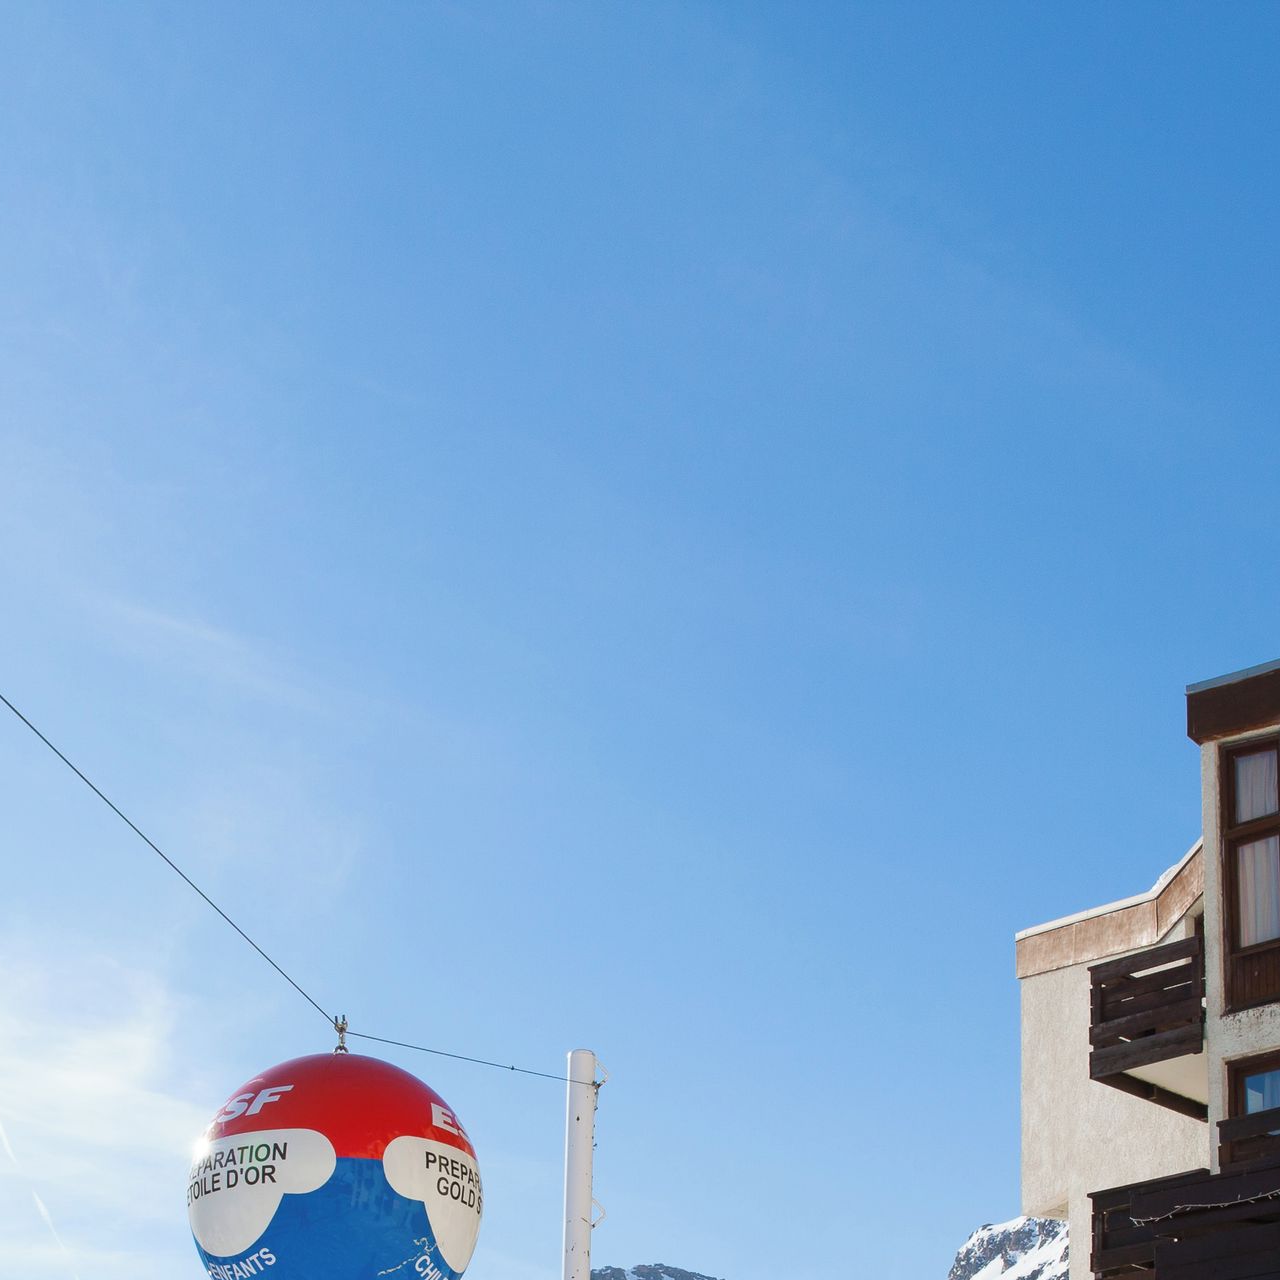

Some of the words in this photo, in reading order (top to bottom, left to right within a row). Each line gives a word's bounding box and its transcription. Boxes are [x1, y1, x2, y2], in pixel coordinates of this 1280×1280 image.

[217, 1084, 294, 1123] SF
[227, 1165, 277, 1188] D'OR
[437, 1177, 476, 1208] GOLD
